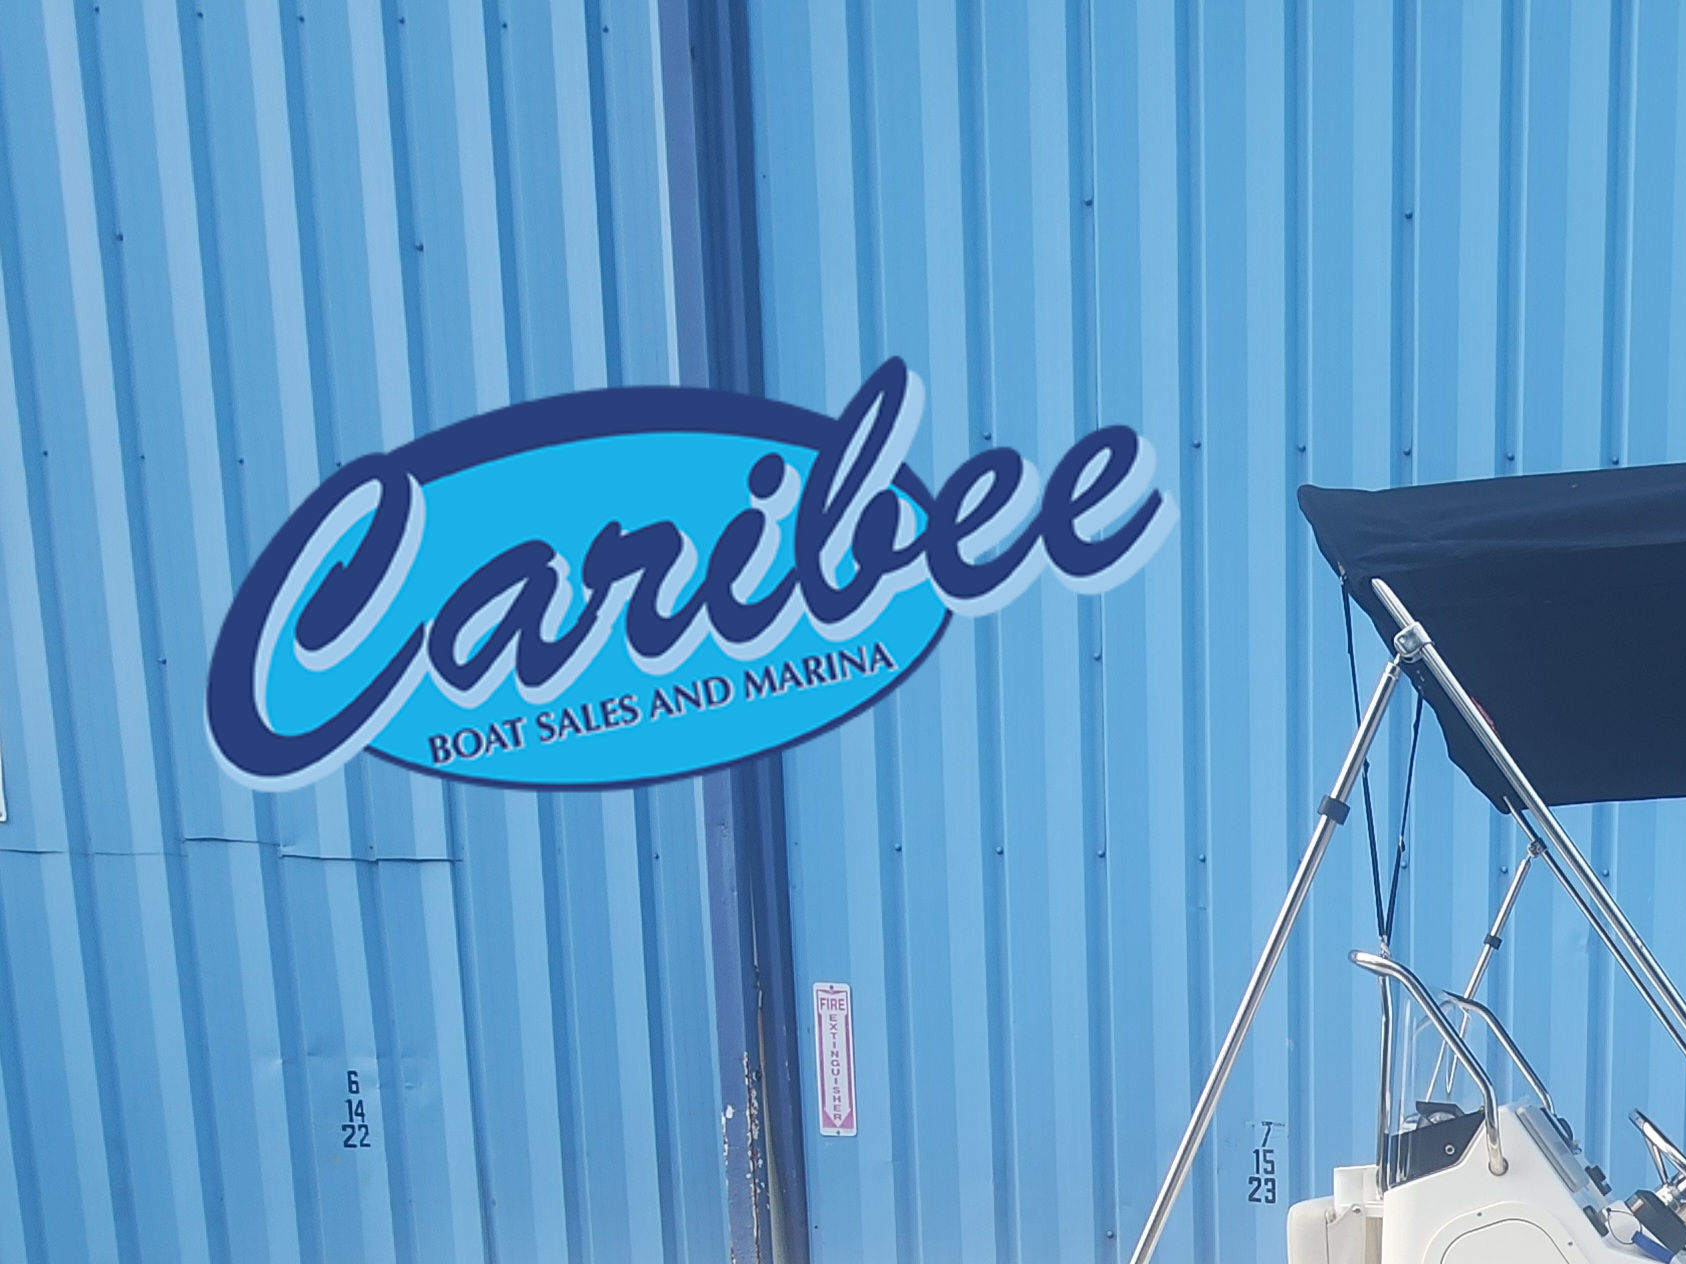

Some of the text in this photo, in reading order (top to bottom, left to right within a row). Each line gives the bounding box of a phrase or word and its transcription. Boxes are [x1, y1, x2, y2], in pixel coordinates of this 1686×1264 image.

[819, 997, 846, 1011] FIRE
[828, 1013, 842, 1121] EXTINGUISHER
[346, 1070, 360, 1095] 6
[345, 1099, 366, 1123] 14
[341, 1124, 371, 1148] 22
[1252, 1149, 1275, 1175] 15
[1247, 1176, 1276, 1204] 23
